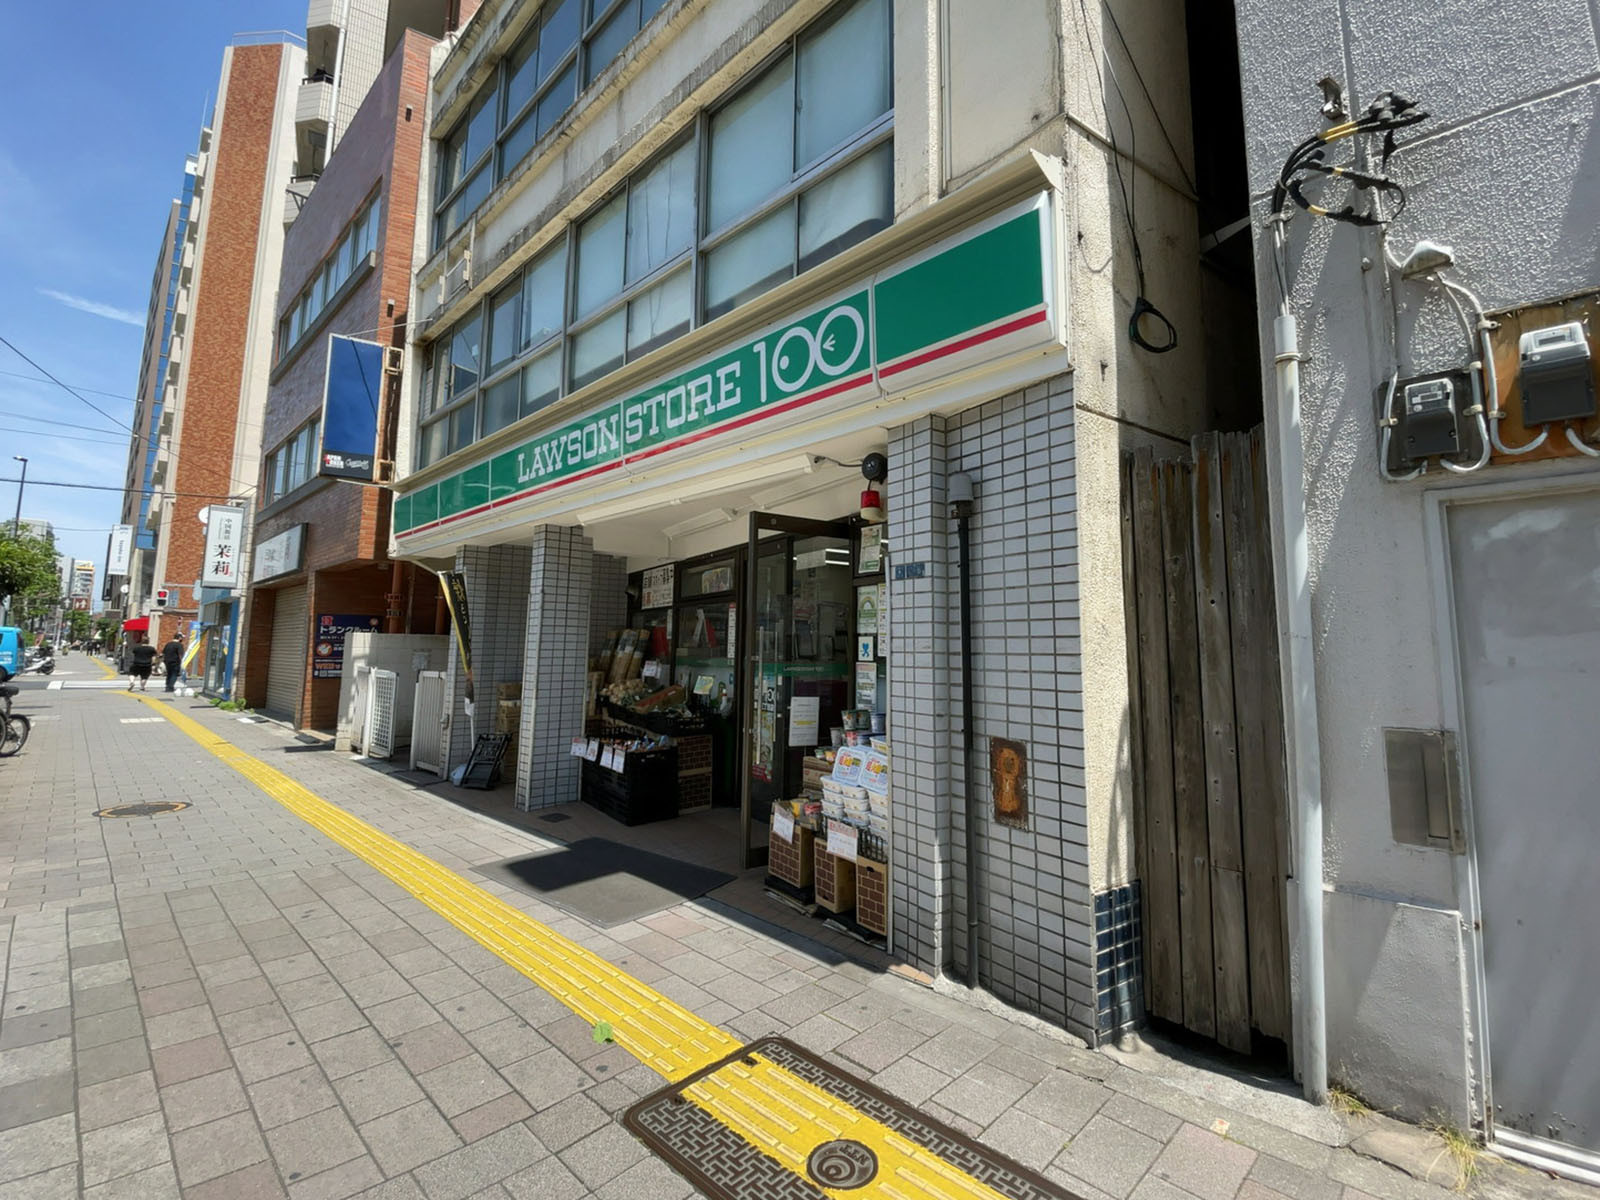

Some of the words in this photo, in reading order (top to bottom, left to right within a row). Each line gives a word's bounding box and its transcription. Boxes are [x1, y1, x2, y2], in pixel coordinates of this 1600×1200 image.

[517, 413, 620, 484] LAWSON
[625, 361, 741, 444] STORE
[753, 305, 865, 403] 100
